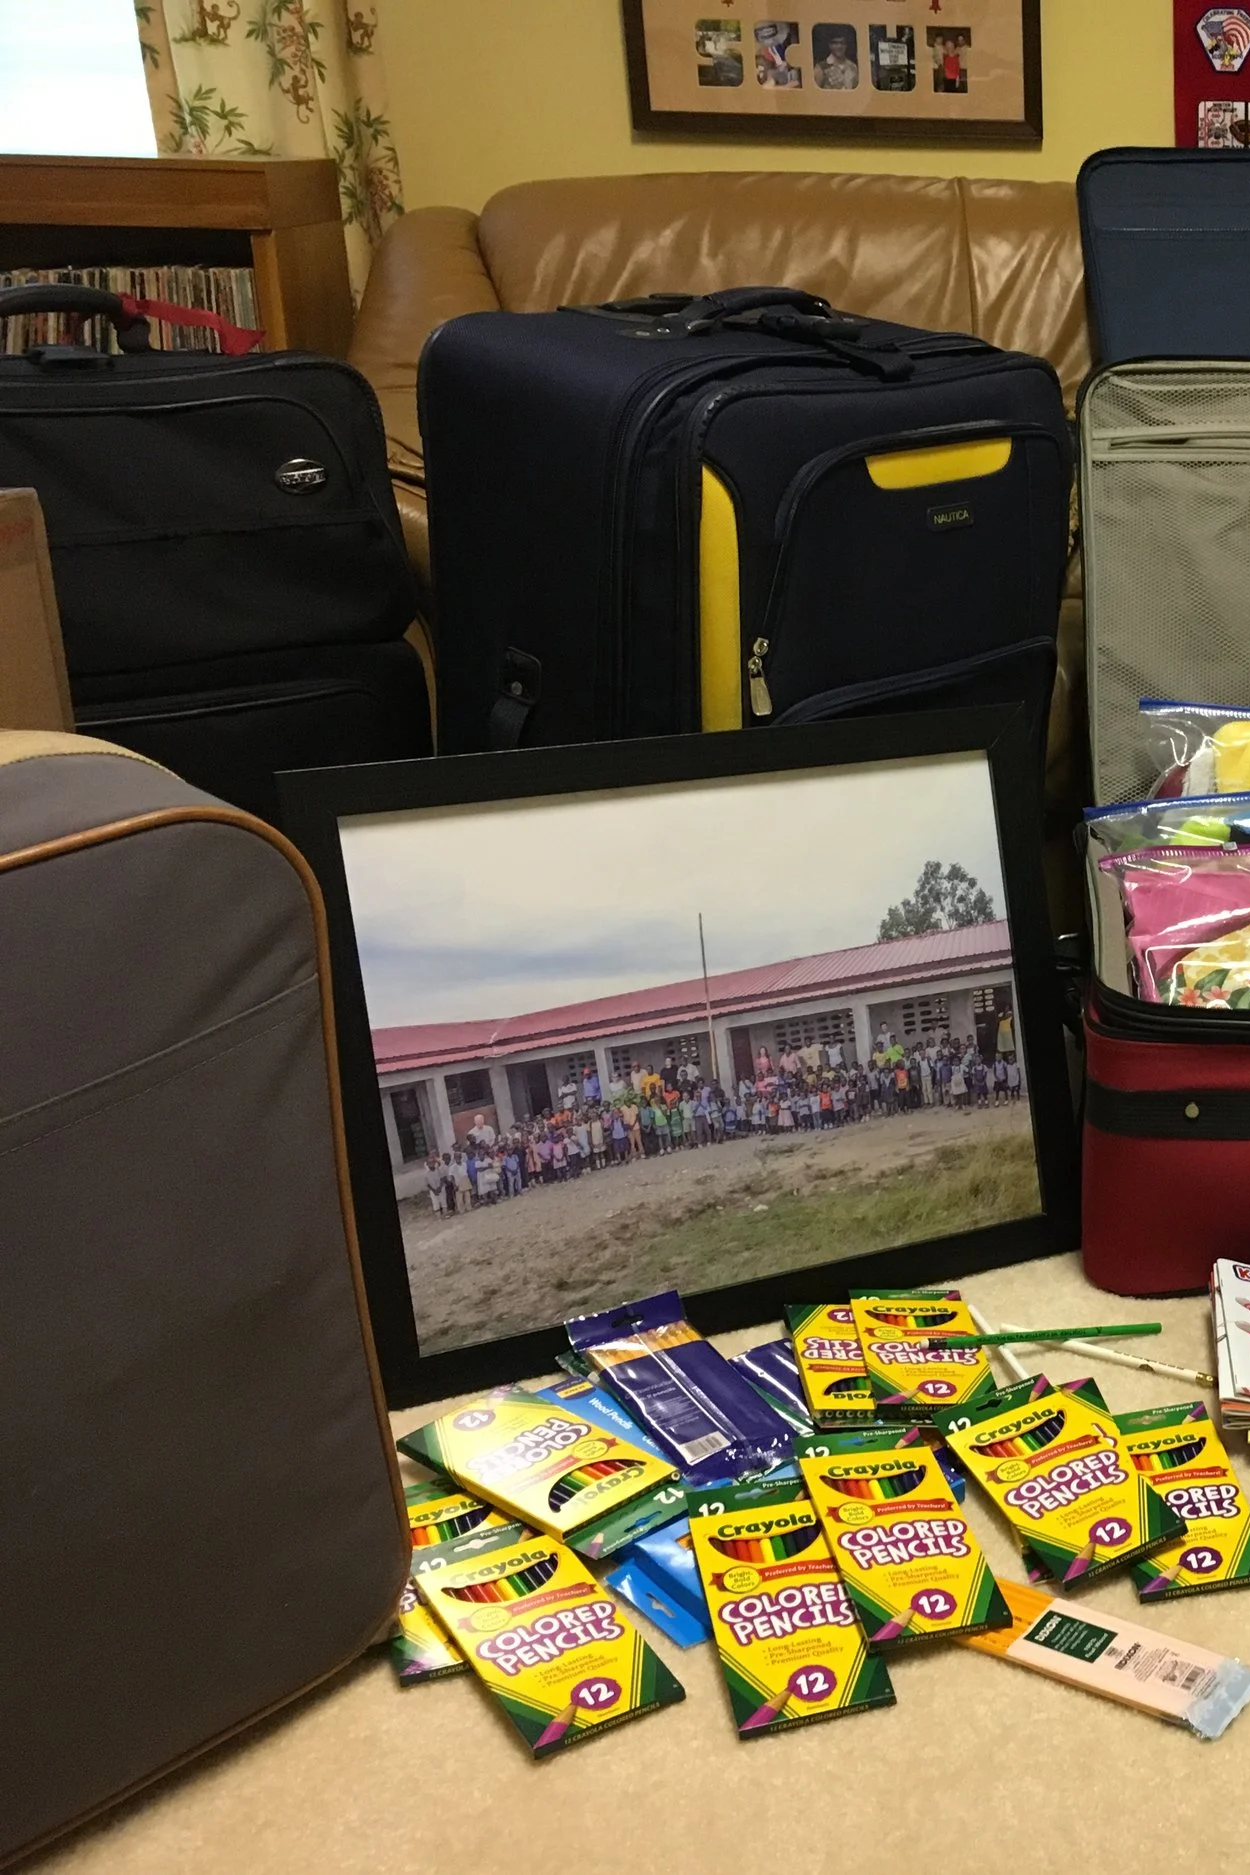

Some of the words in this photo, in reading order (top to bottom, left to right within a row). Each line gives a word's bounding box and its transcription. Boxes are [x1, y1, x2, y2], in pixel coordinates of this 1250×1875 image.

[934, 509, 969, 525] NAUTICA
[872, 1305, 949, 1314] Crayola
[806, 1338, 858, 1351] CILS
[804, 1349, 864, 1361] ORED
[878, 1352, 978, 1366] PENCILS
[925, 1384, 950, 1395] 12
[588, 1397, 613, 1417] Wood
[1152, 1404, 1194, 1415] Pre-Sharpened
[459, 1412, 490, 1429] 12
[948, 1416, 972, 1434] 12
[975, 1408, 1056, 1445] Crayola
[863, 1428, 907, 1436] Pre-Sharpened
[805, 1446, 831, 1459] 12
[1126, 1434, 1197, 1452] rayola
[827, 1460, 917, 1479] Crayola
[1006, 1451, 1117, 1505] COLORED
[762, 1479, 801, 1489] Pre-Sharpe
[1021, 1466, 1127, 1518] PENCILS
[653, 1487, 685, 1505] 12
[1167, 1484, 1238, 1508] ORED
[410, 1500, 484, 1524] ayola
[698, 1503, 725, 1518] 12
[877, 1504, 907, 1513] Preferred
[1173, 1499, 1239, 1519] CILS
[479, 1522, 522, 1538] Pre-Sharpen
[718, 1512, 815, 1538] Crayola
[1095, 1522, 1127, 1543] 12
[840, 1520, 965, 1550] COLORED
[853, 1536, 969, 1569] PENCILS
[1186, 1551, 1217, 1570] 12
[450, 1549, 549, 1586] Crayola
[764, 1567, 797, 1578] Preferred
[797, 1565, 807, 1574] by
[721, 1585, 847, 1624] COLORE
[918, 1594, 951, 1615] 12
[479, 1601, 614, 1660] COLORED
[733, 1603, 856, 1646] PENCILS
[1034, 1615, 1063, 1643] DIXON
[495, 1617, 624, 1676] PENCILS
[796, 1672, 830, 1695] 12
[578, 1682, 615, 1706] 12
